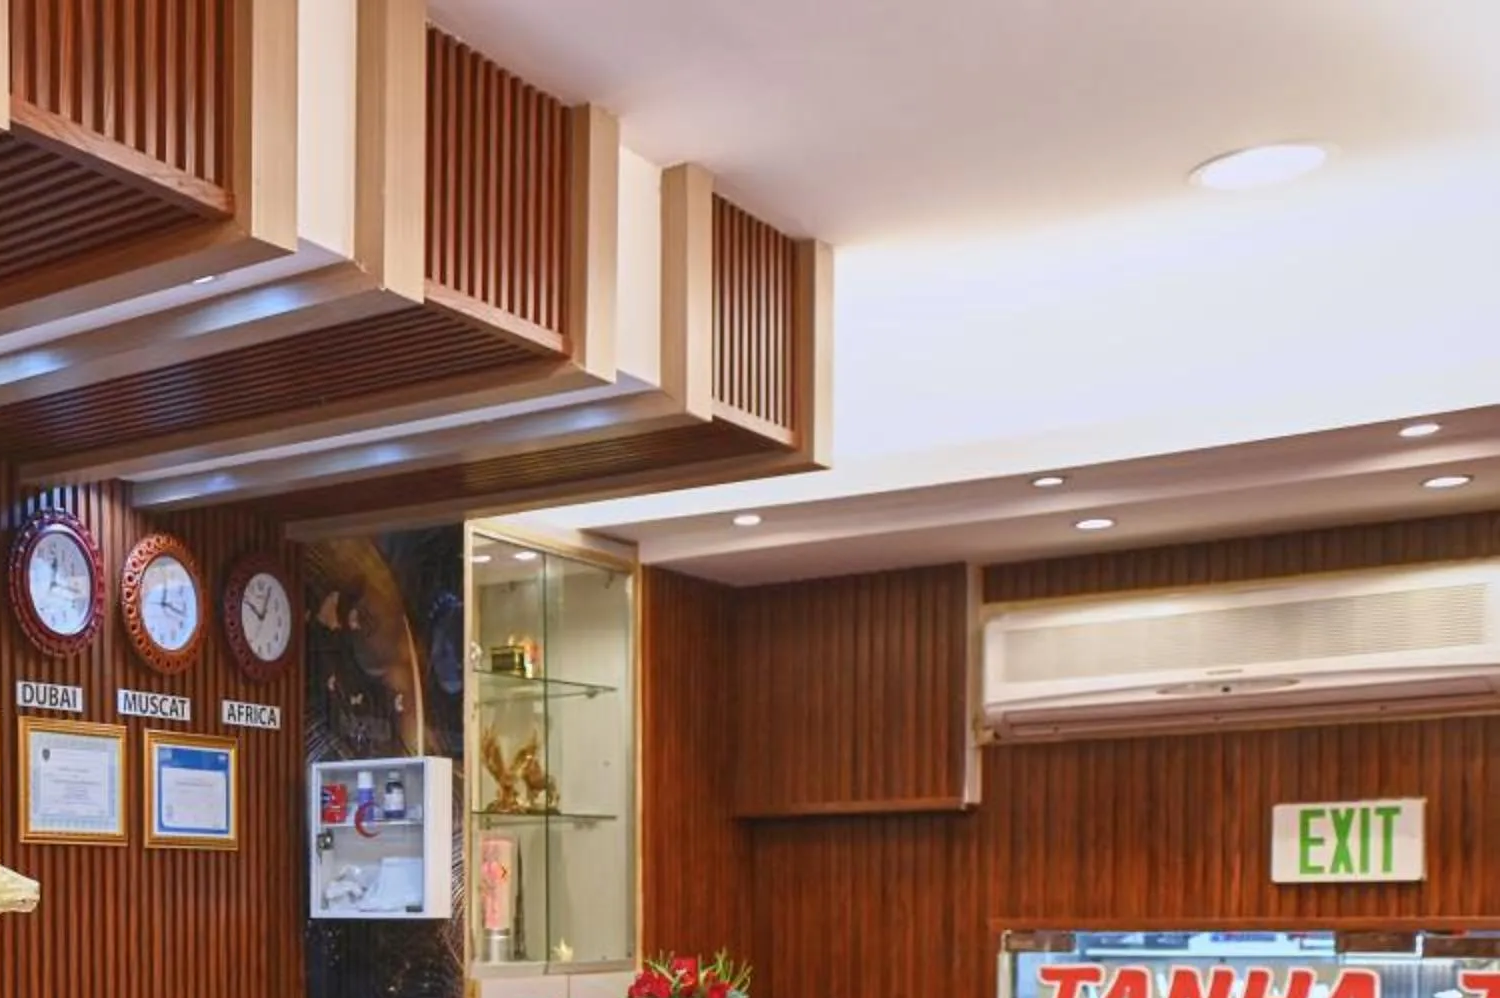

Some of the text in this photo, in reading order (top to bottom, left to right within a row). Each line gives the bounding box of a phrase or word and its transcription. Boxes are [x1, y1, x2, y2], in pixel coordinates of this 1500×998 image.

[22, 683, 77, 709] DUBAI
[123, 693, 187, 719] MUSCAT
[227, 704, 277, 727] AFRICA
[1298, 806, 1401, 875] EXIT
